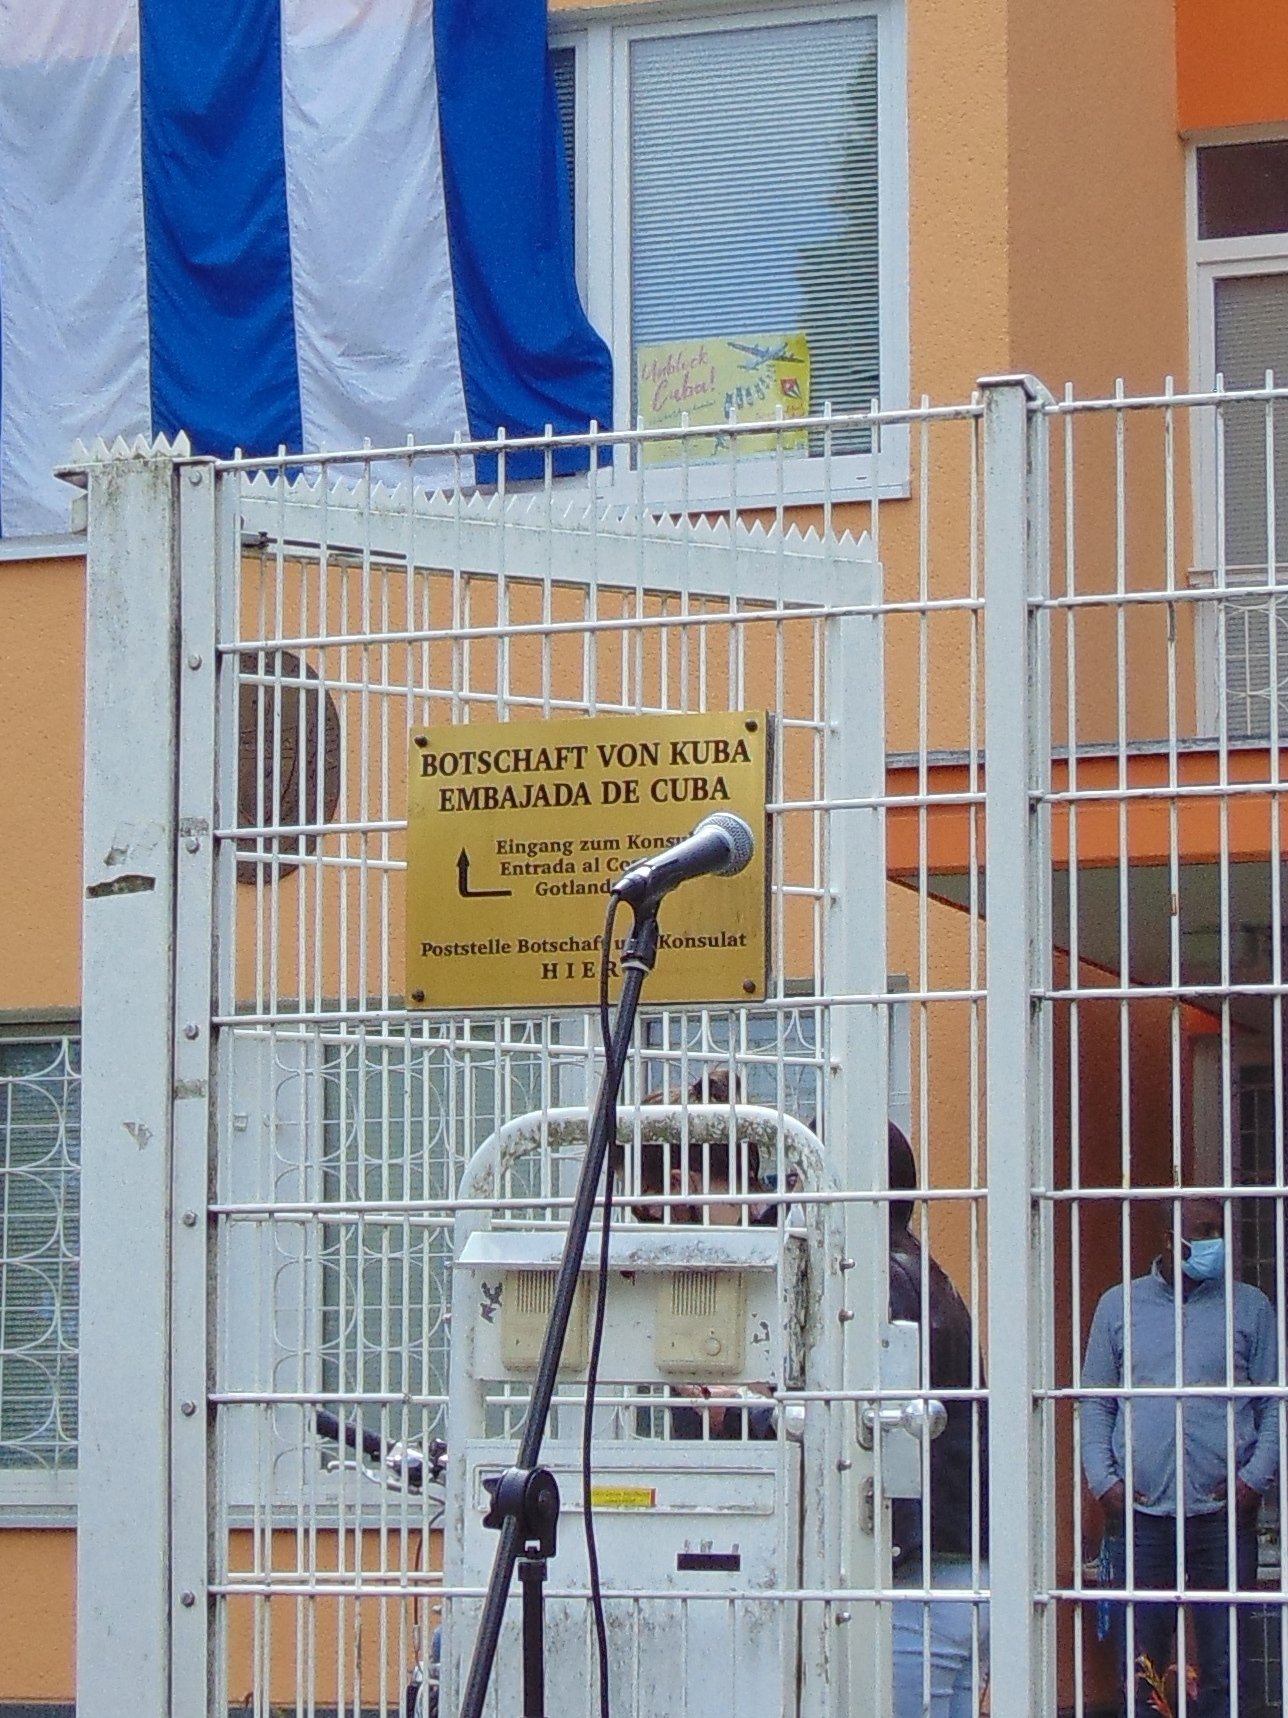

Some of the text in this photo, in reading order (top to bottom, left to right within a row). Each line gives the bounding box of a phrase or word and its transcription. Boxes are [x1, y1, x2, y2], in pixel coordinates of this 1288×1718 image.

[641, 345, 709, 383] Unblock
[652, 366, 717, 412] Cuba!
[420, 739, 752, 778] BOTSCHAFT VON KUBA
[439, 776, 730, 812] EMBAJADA DE CUBA
[496, 838, 574, 858] Eingang
[579, 838, 620, 851] zum
[500, 859, 576, 877] Entrada
[582, 857, 600, 874] al
[535, 879, 613, 897] Gotland
[421, 939, 512, 957] Poststelle
[517, 935, 608, 954] Botschaf
[658, 933, 747, 950] Konsulat
